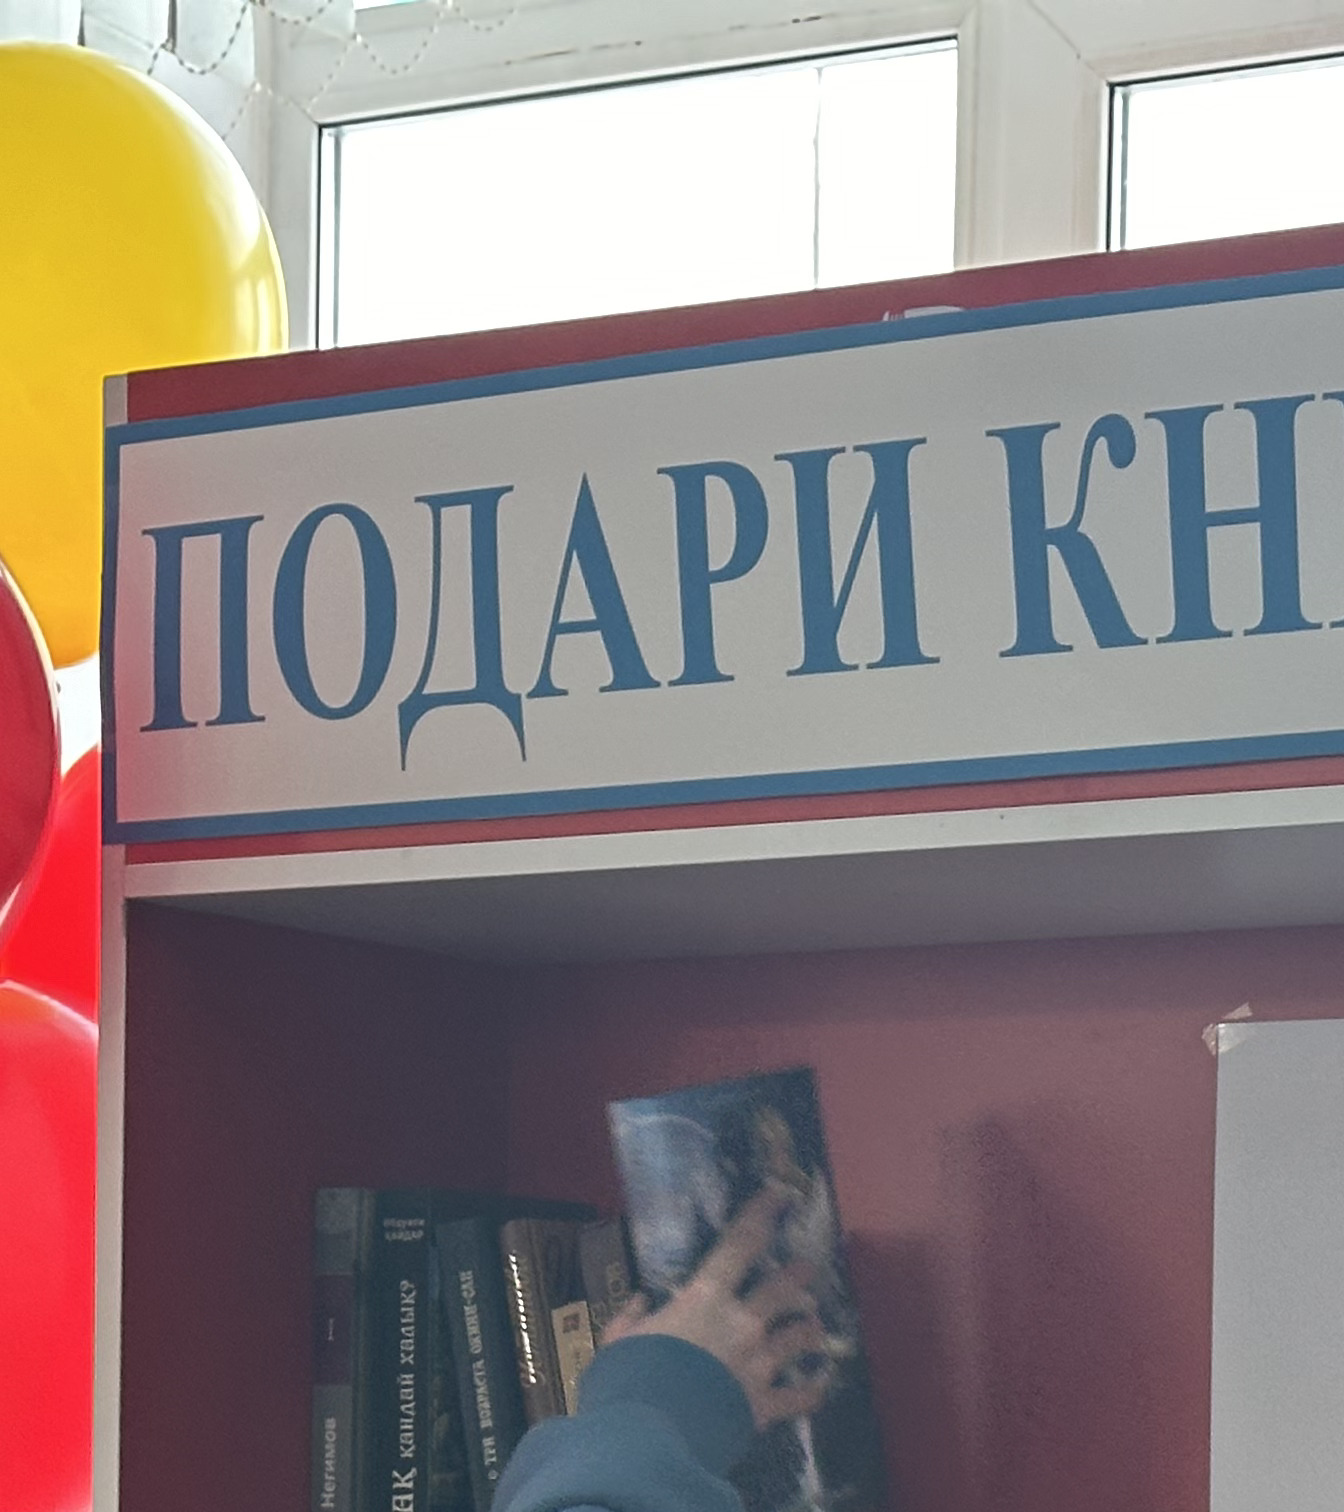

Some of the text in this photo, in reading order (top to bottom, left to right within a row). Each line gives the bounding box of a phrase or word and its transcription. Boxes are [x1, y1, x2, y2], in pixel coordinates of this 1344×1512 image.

[140, 438, 941, 770] ПОДАРИ
[459, 1270, 483, 1354] ОКИНИ-САН
[473, 1360, 492, 1428] ВОЗРАСТА
[320, 1417, 338, 1508] Негимов
